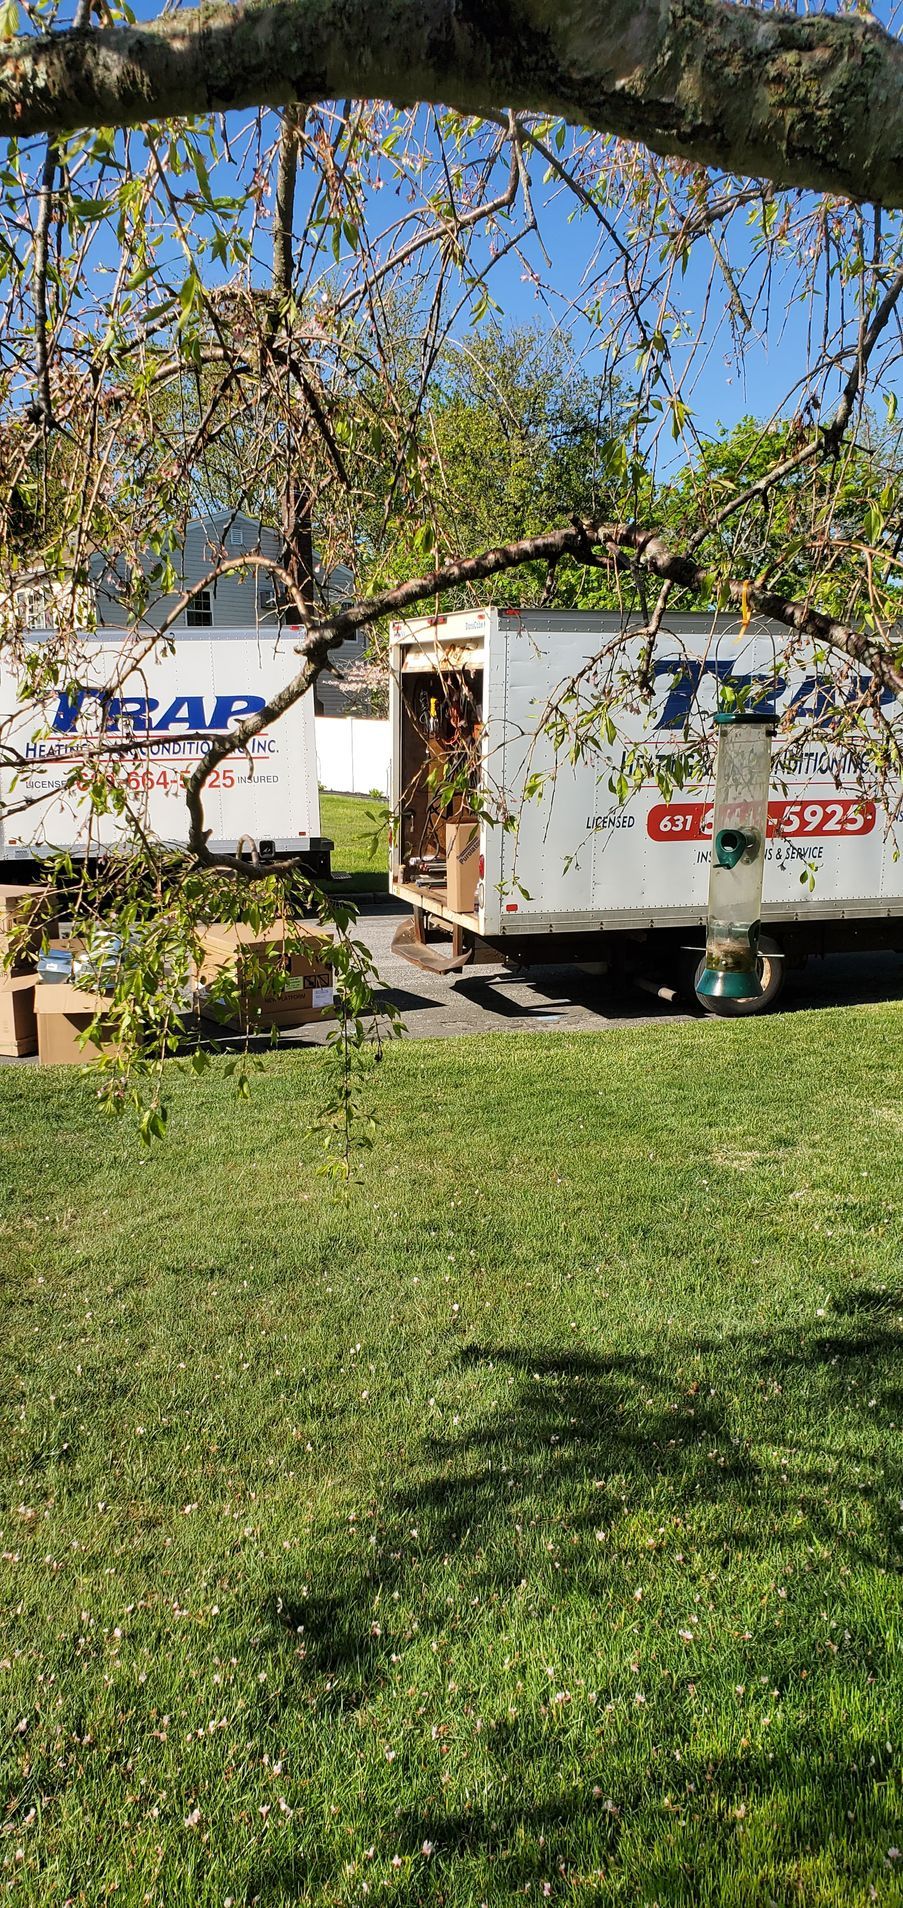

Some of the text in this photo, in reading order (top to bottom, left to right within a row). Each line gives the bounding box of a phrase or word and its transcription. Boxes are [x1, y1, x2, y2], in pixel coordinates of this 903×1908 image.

[652, 660, 897, 730] TRAP
[52, 689, 266, 732] TRAP
[26, 743, 88, 758] HEATIN
[139, 741, 245, 756] CONDITIO
[252, 738, 279, 753] INC.
[620, 751, 698, 777] HTIG
[774, 750, 871, 775] NDITIONING
[26, 769, 279, 791] LICENSE -664-525 INSURED
[586, 803, 864, 835] LICENSED 631 6-5925
[785, 847, 824, 860] SERVICE
